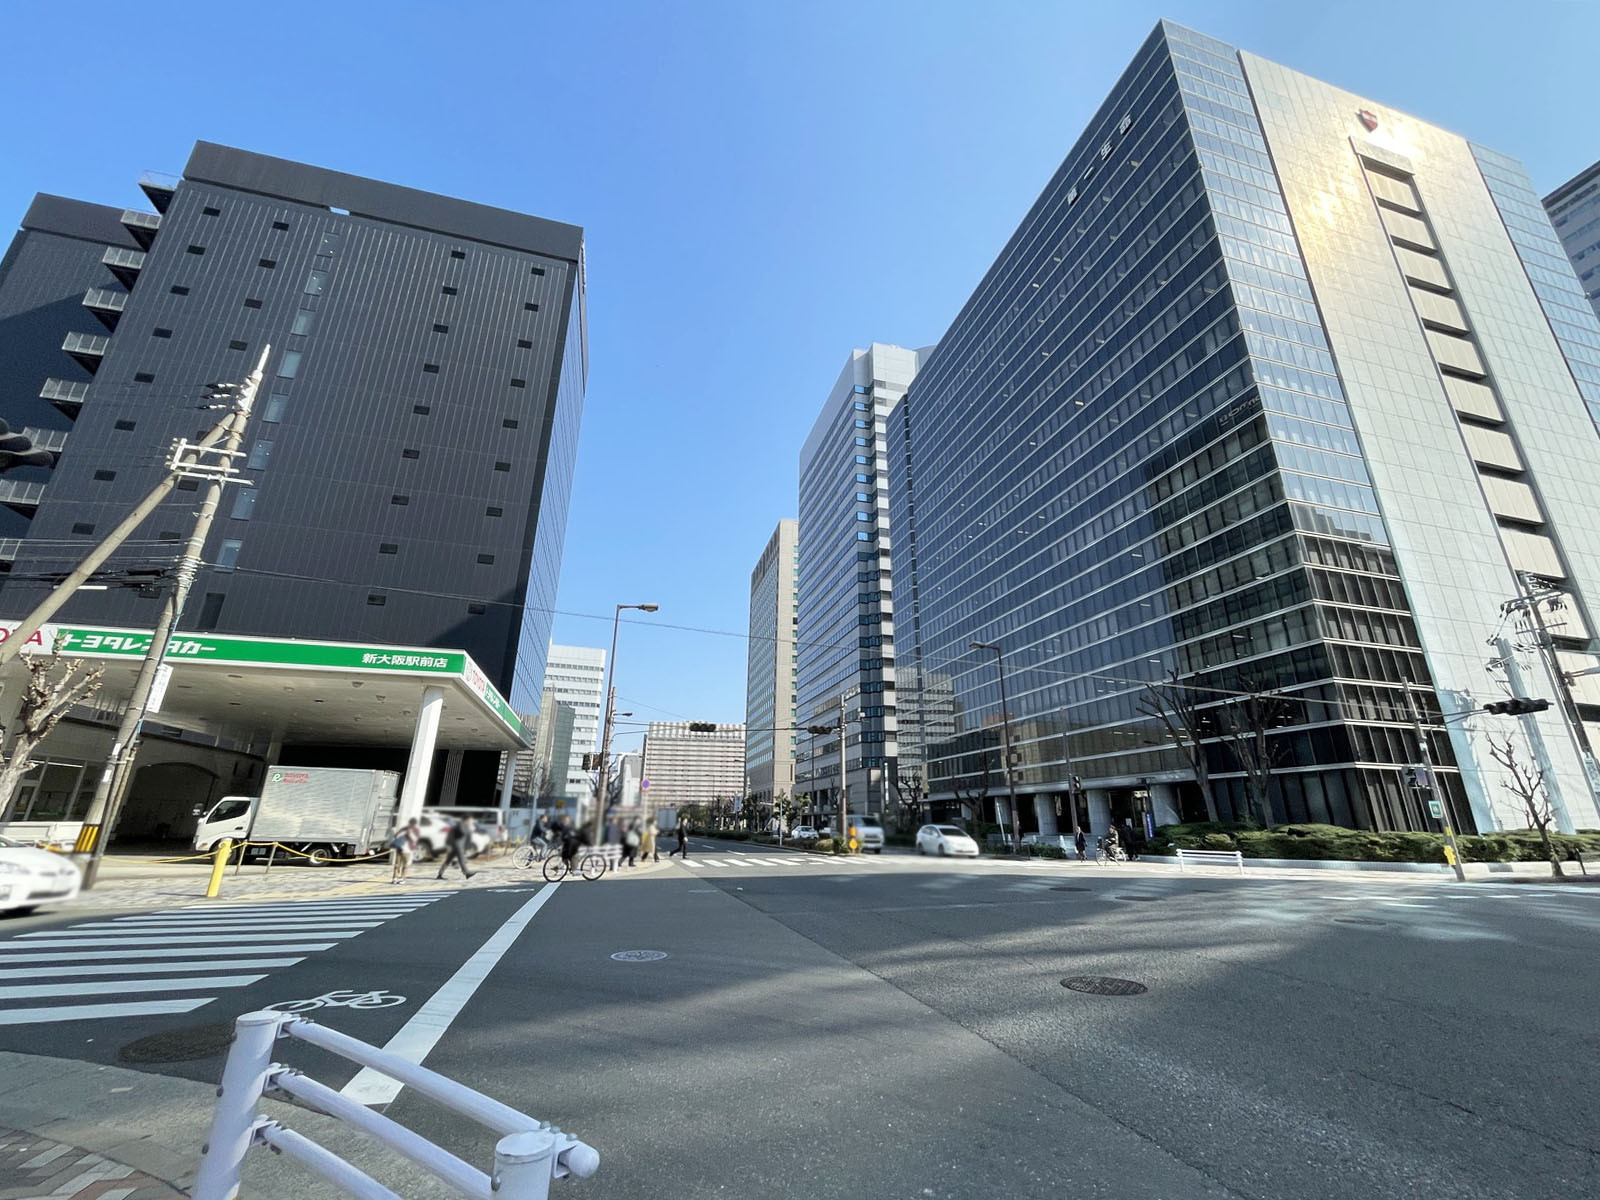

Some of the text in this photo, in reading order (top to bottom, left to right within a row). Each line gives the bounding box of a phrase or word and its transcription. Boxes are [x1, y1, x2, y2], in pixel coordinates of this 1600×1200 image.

[361, 653, 448, 668] 新大阪駅前店
